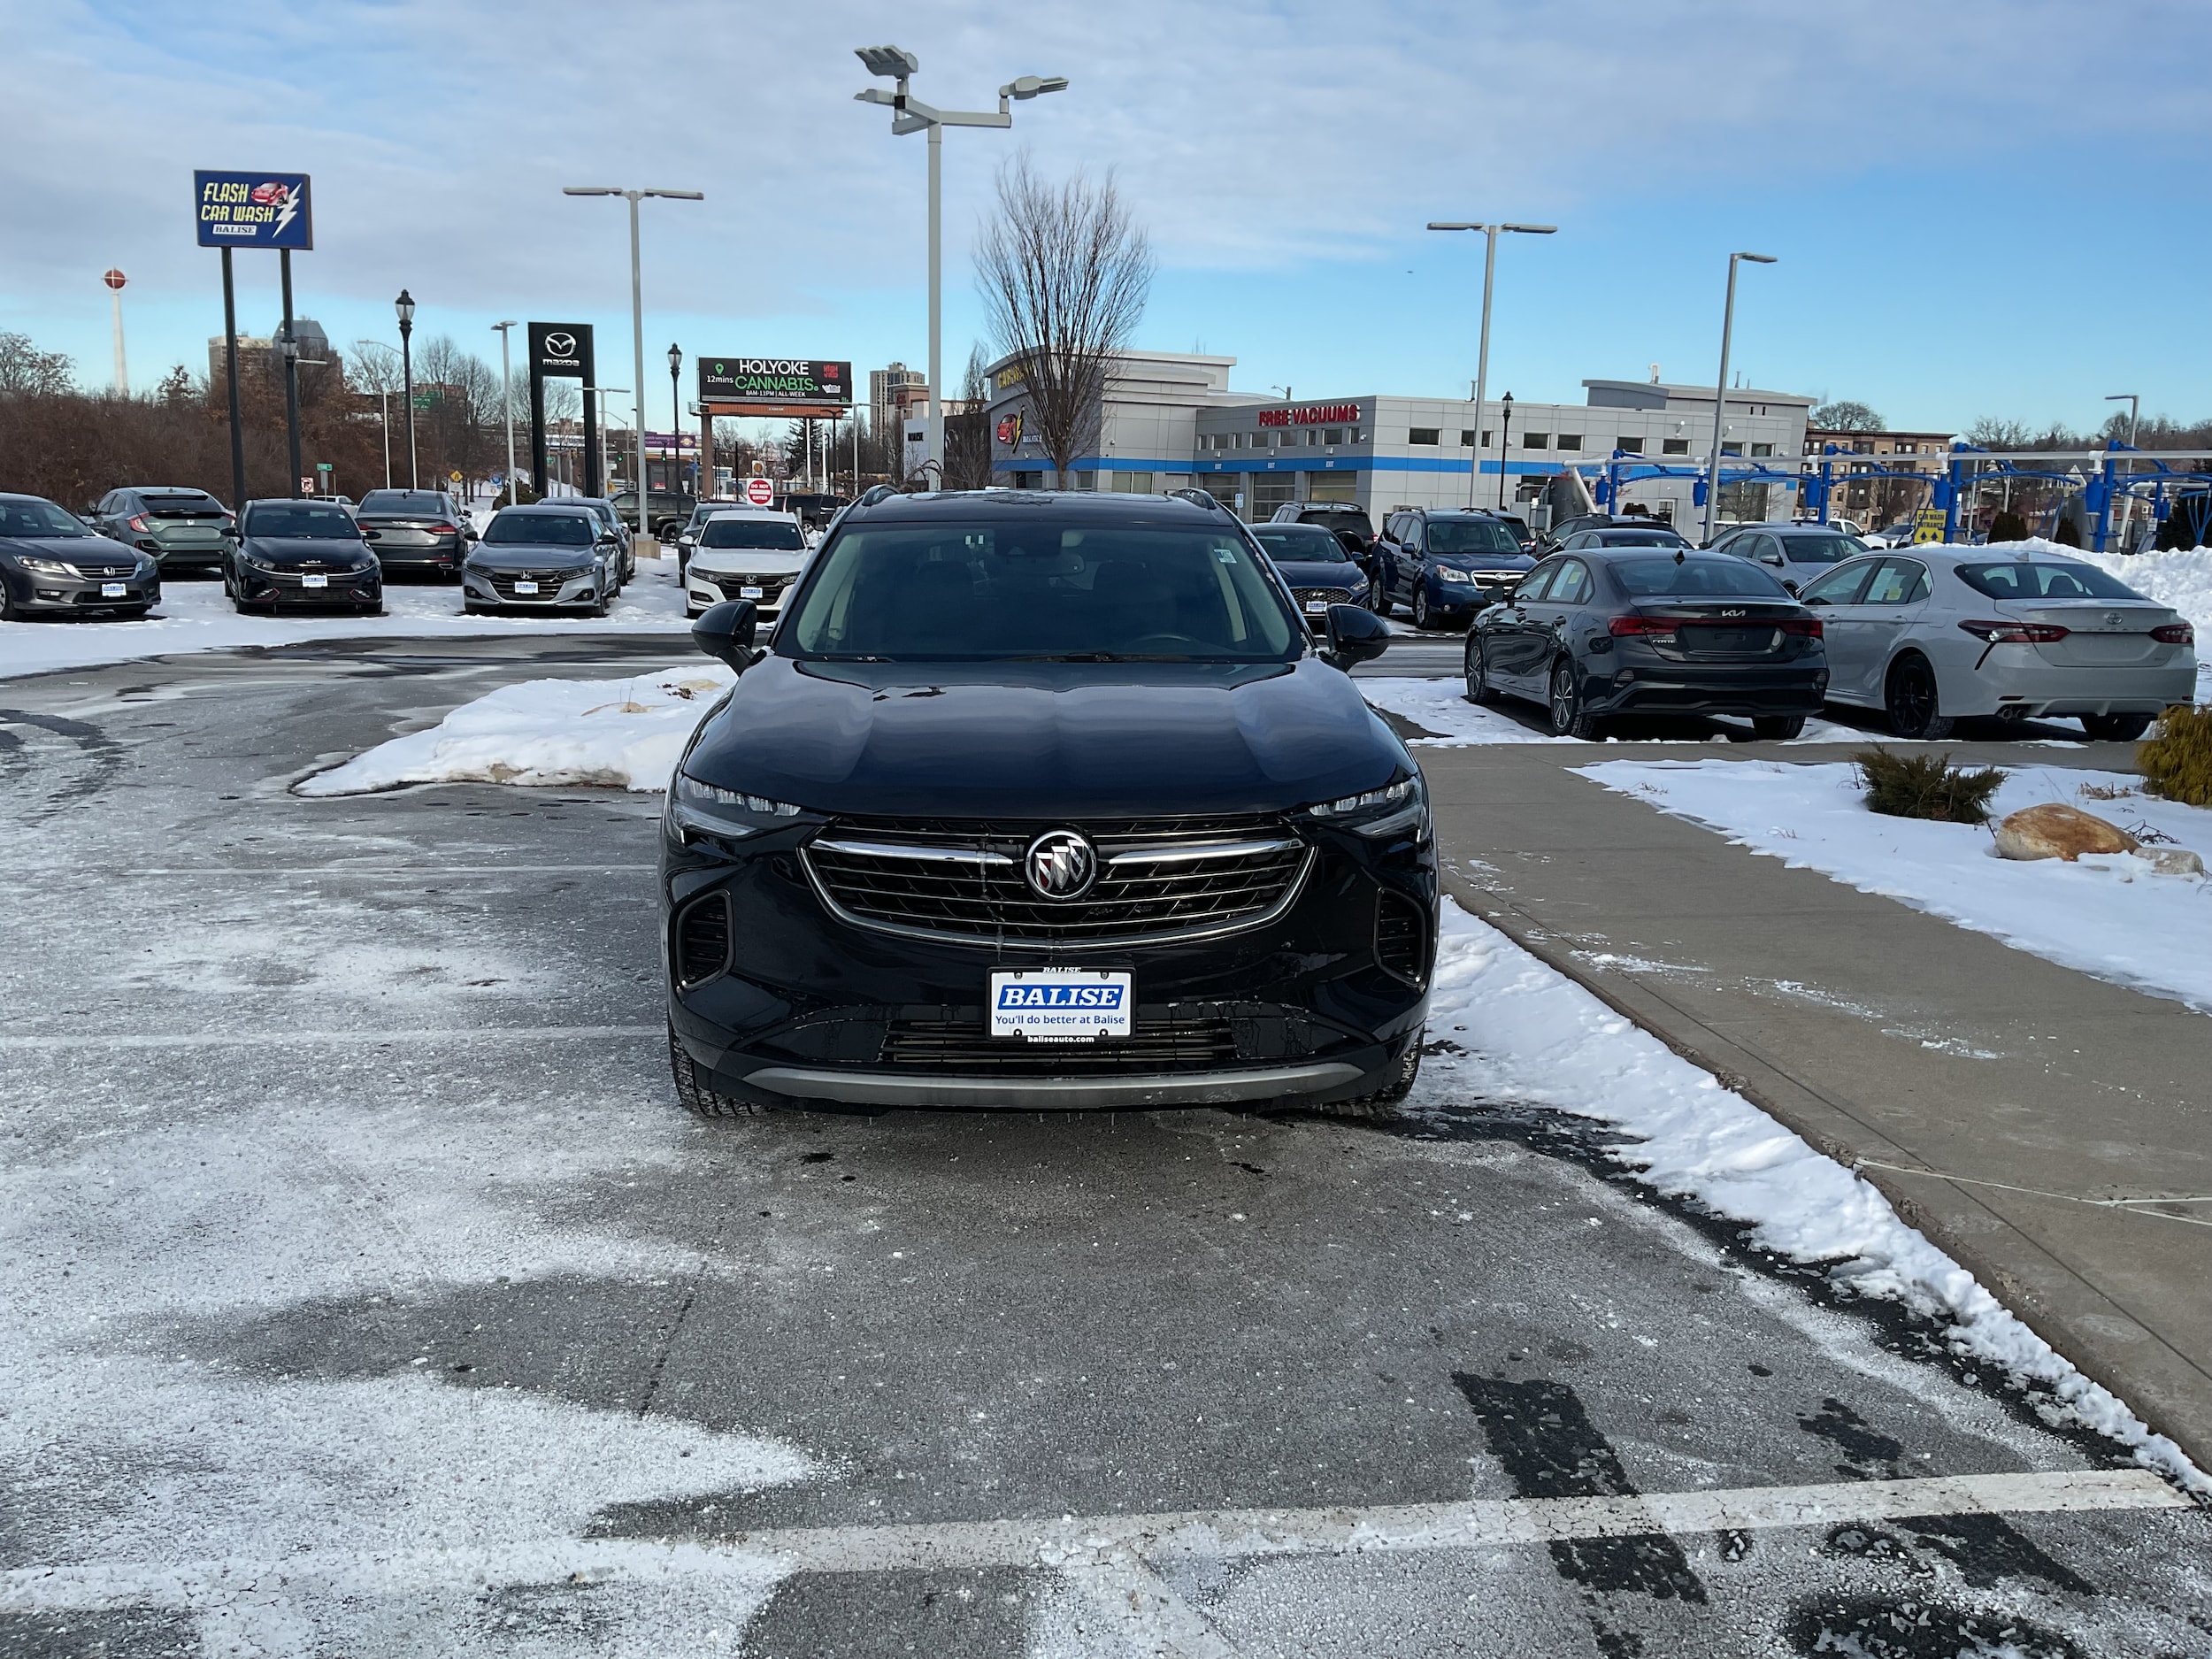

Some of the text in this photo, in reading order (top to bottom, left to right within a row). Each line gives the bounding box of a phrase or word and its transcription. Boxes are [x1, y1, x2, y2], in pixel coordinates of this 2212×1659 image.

[203, 182, 250, 203] FLASH
[201, 204, 274, 222] CAR WASH
[739, 359, 810, 376] HOLYOKE
[706, 375, 733, 384] 12mins
[1258, 404, 1361, 426] FREE VACUUMS
[1002, 987, 1120, 1007] BALISE
[995, 1015, 1125, 1025] You'll do better at Balise
